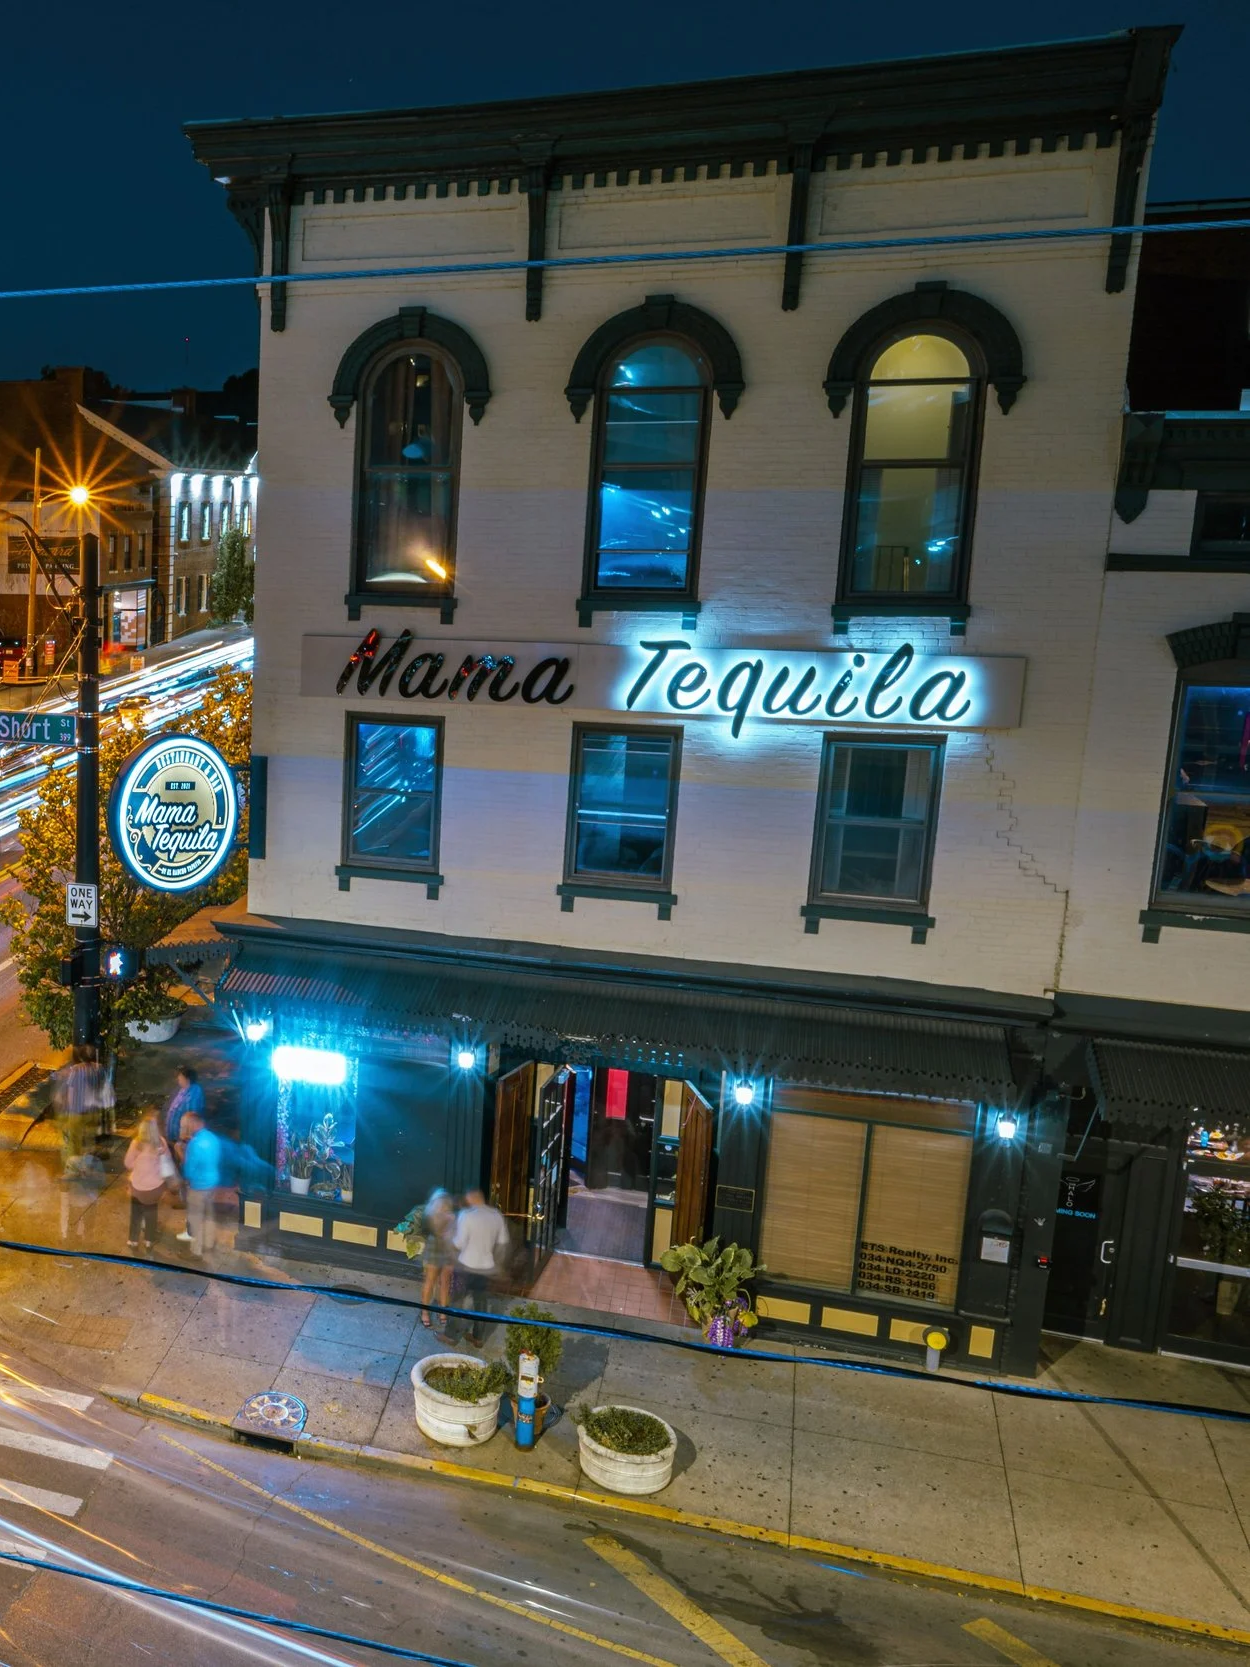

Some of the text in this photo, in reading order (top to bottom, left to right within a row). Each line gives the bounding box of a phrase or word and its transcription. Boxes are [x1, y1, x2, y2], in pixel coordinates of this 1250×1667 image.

[336, 627, 972, 738] Mama Tequila
[60, 718, 71, 728] St
[134, 795, 197, 824] Mama
[152, 823, 219, 859] Tequila
[70, 887, 93, 899] ONE
[70, 899, 93, 910] WAY
[1074, 1210, 1097, 1220] SOON
[861, 1241, 885, 1252] ETS
